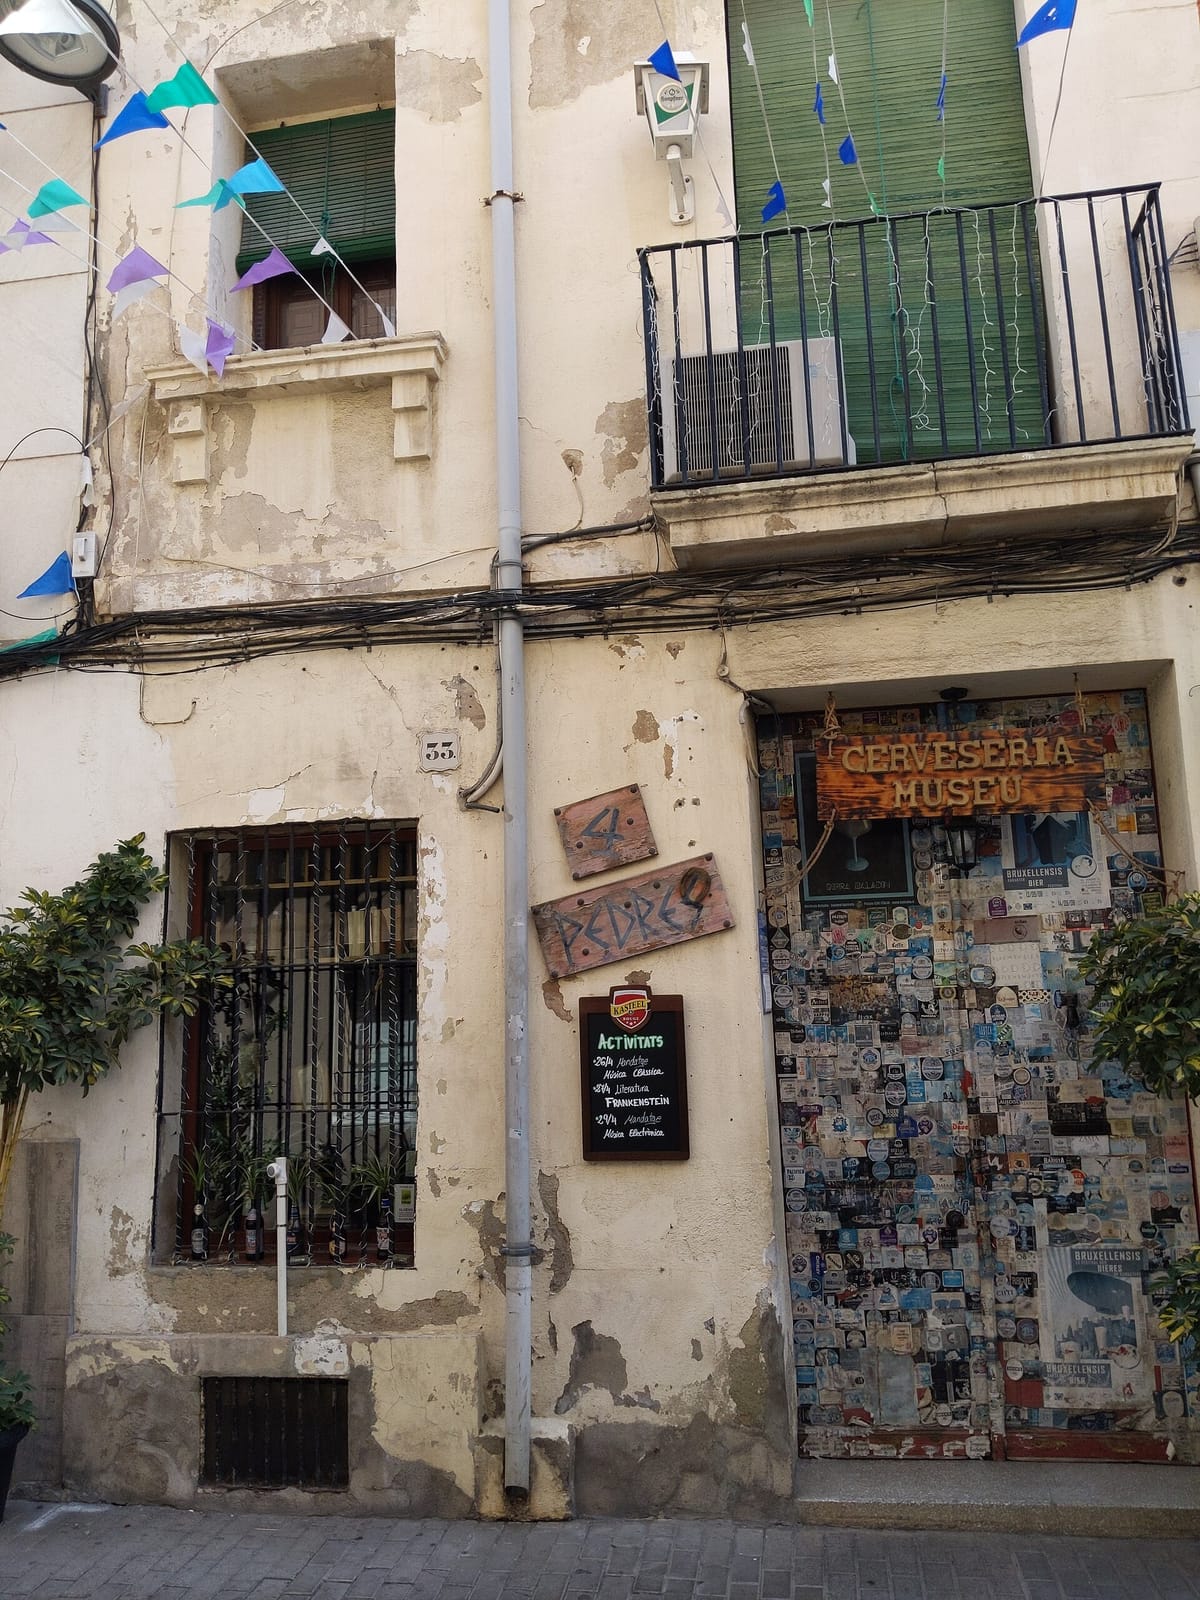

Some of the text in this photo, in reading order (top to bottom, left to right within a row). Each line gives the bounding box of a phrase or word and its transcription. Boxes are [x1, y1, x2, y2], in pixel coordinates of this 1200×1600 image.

[842, 737, 1076, 773] CERVESERIA
[893, 775, 1022, 808] MUSEU
[582, 807, 624, 851] 4
[1006, 867, 1063, 878] BRUXELLENSIS
[613, 1000, 647, 1016] KASTEEL
[598, 1033, 664, 1050] ACTIVITATS
[605, 1094, 670, 1108] FRANKENSTEIN
[1074, 1251, 1141, 1261] BRUXELLENSIS
[1046, 1364, 1106, 1375] BRUXELLENSIS
